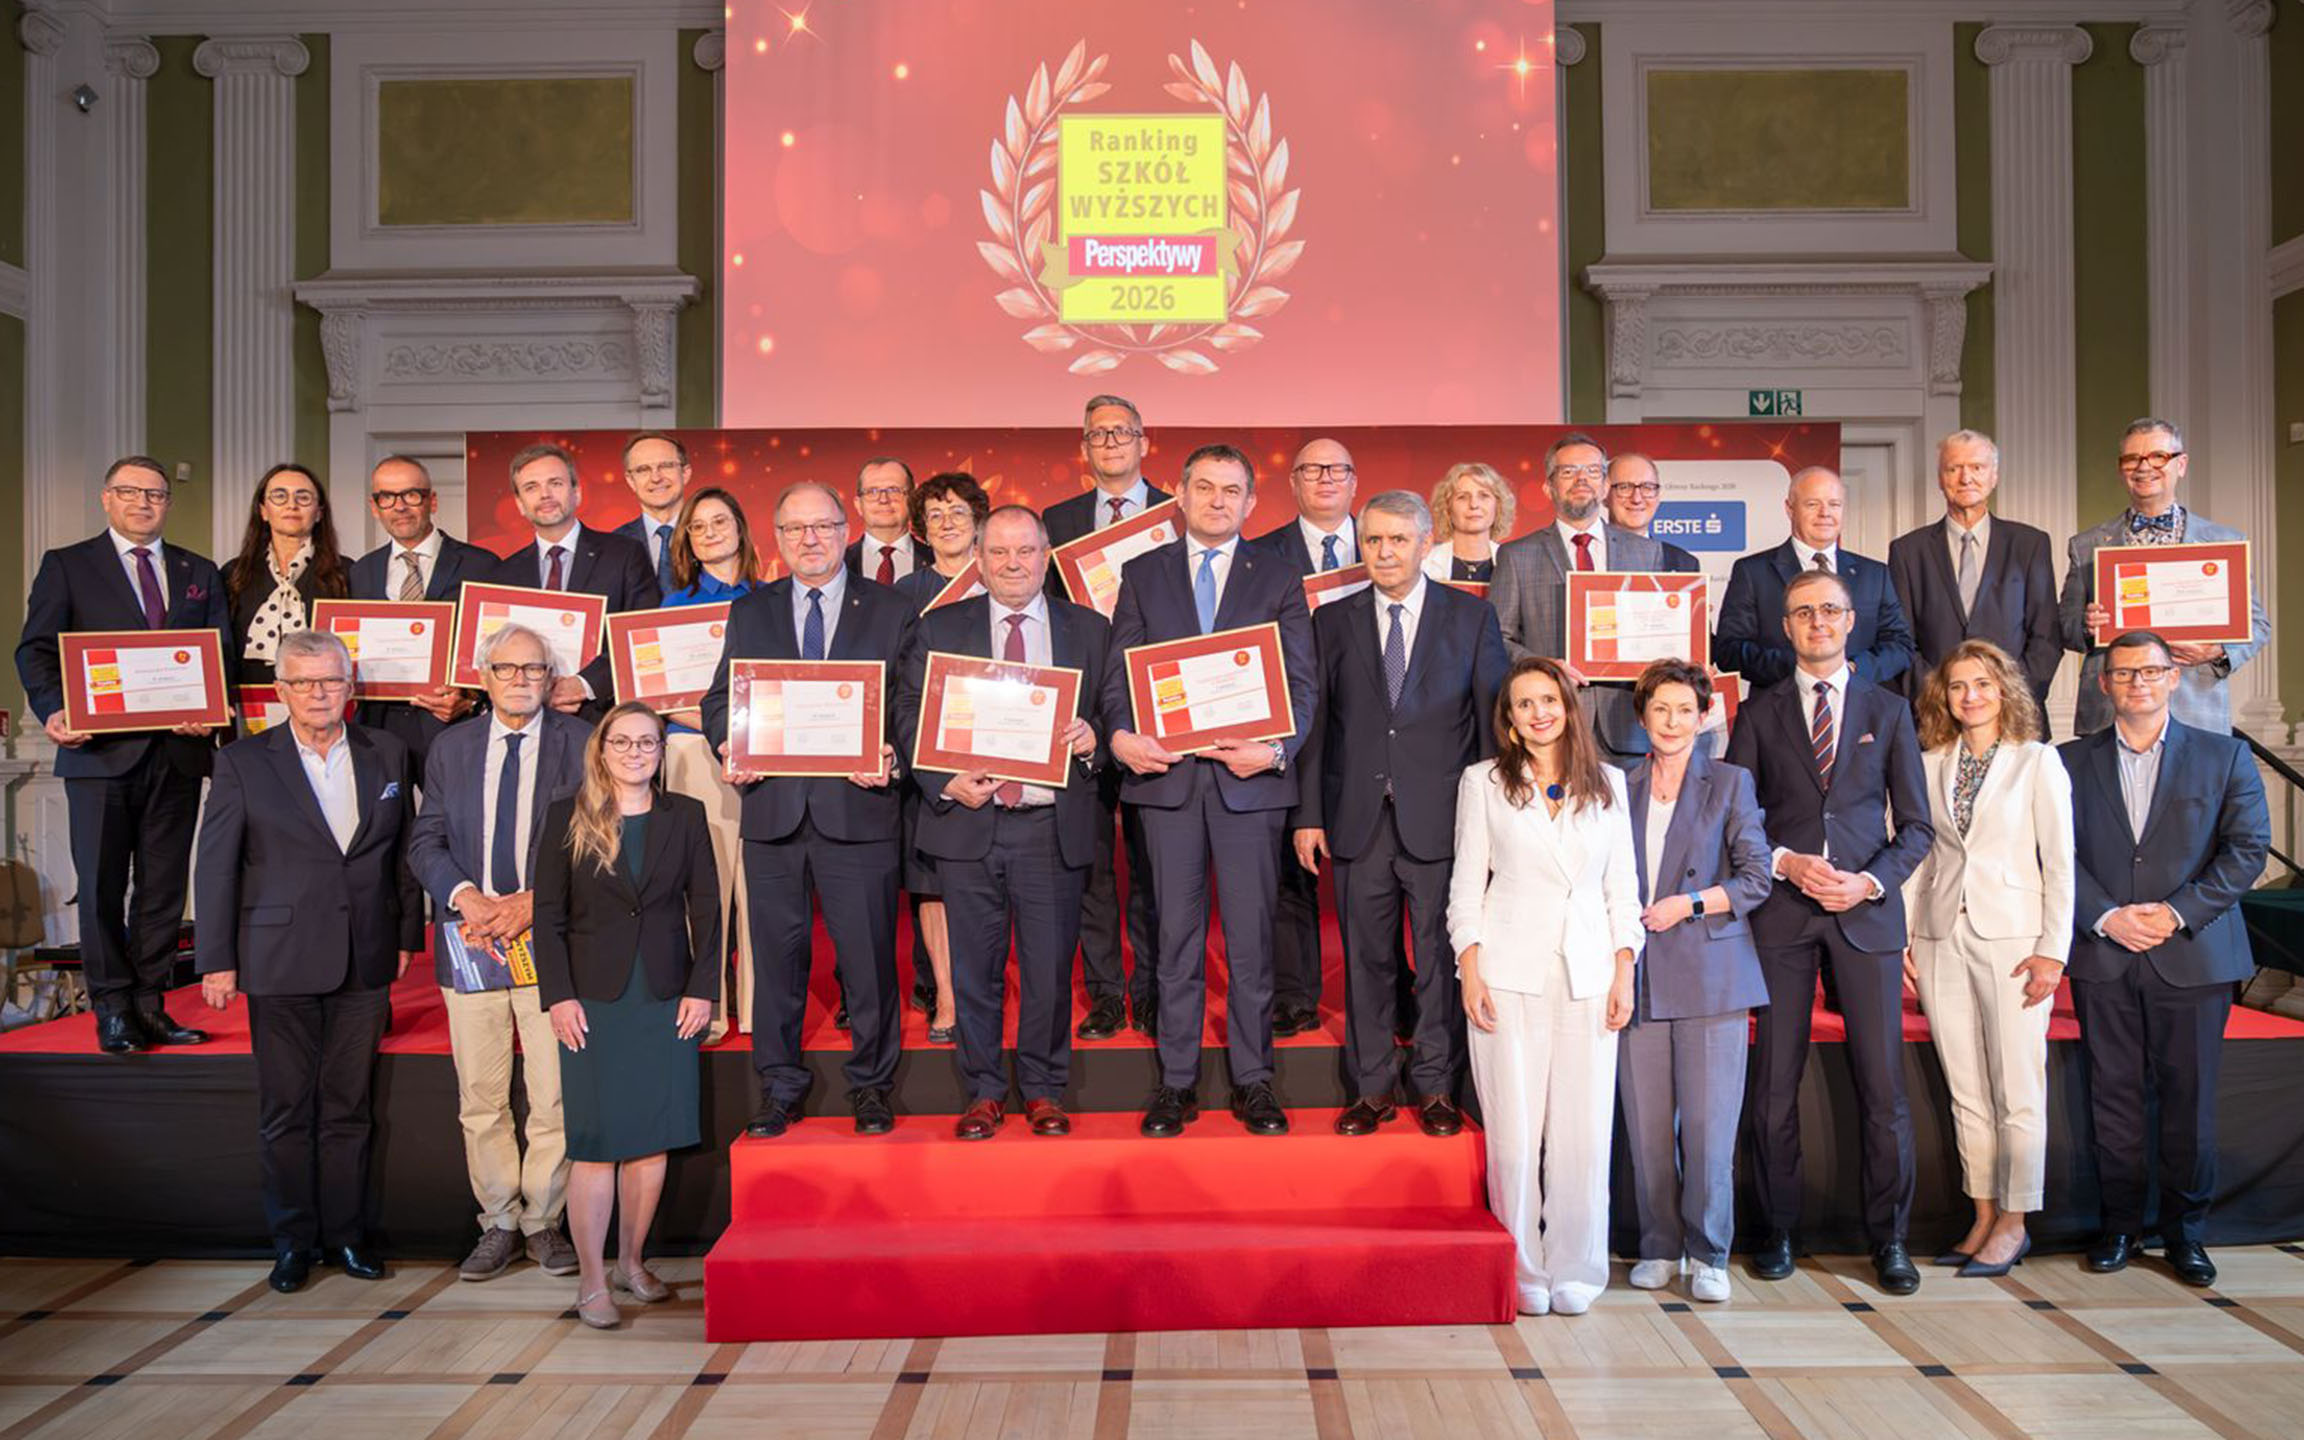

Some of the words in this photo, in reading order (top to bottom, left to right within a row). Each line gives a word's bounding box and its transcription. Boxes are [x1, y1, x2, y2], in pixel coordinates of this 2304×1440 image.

[1090, 129, 1198, 156] Ranking
[1099, 154, 1190, 184] SZKÓŁ
[1070, 188, 1218, 218] WYŻSZYCH
[1085, 238, 1202, 273] Perspektywy
[1110, 285, 1175, 311] 2026
[1653, 519, 1702, 534] ERSTE
